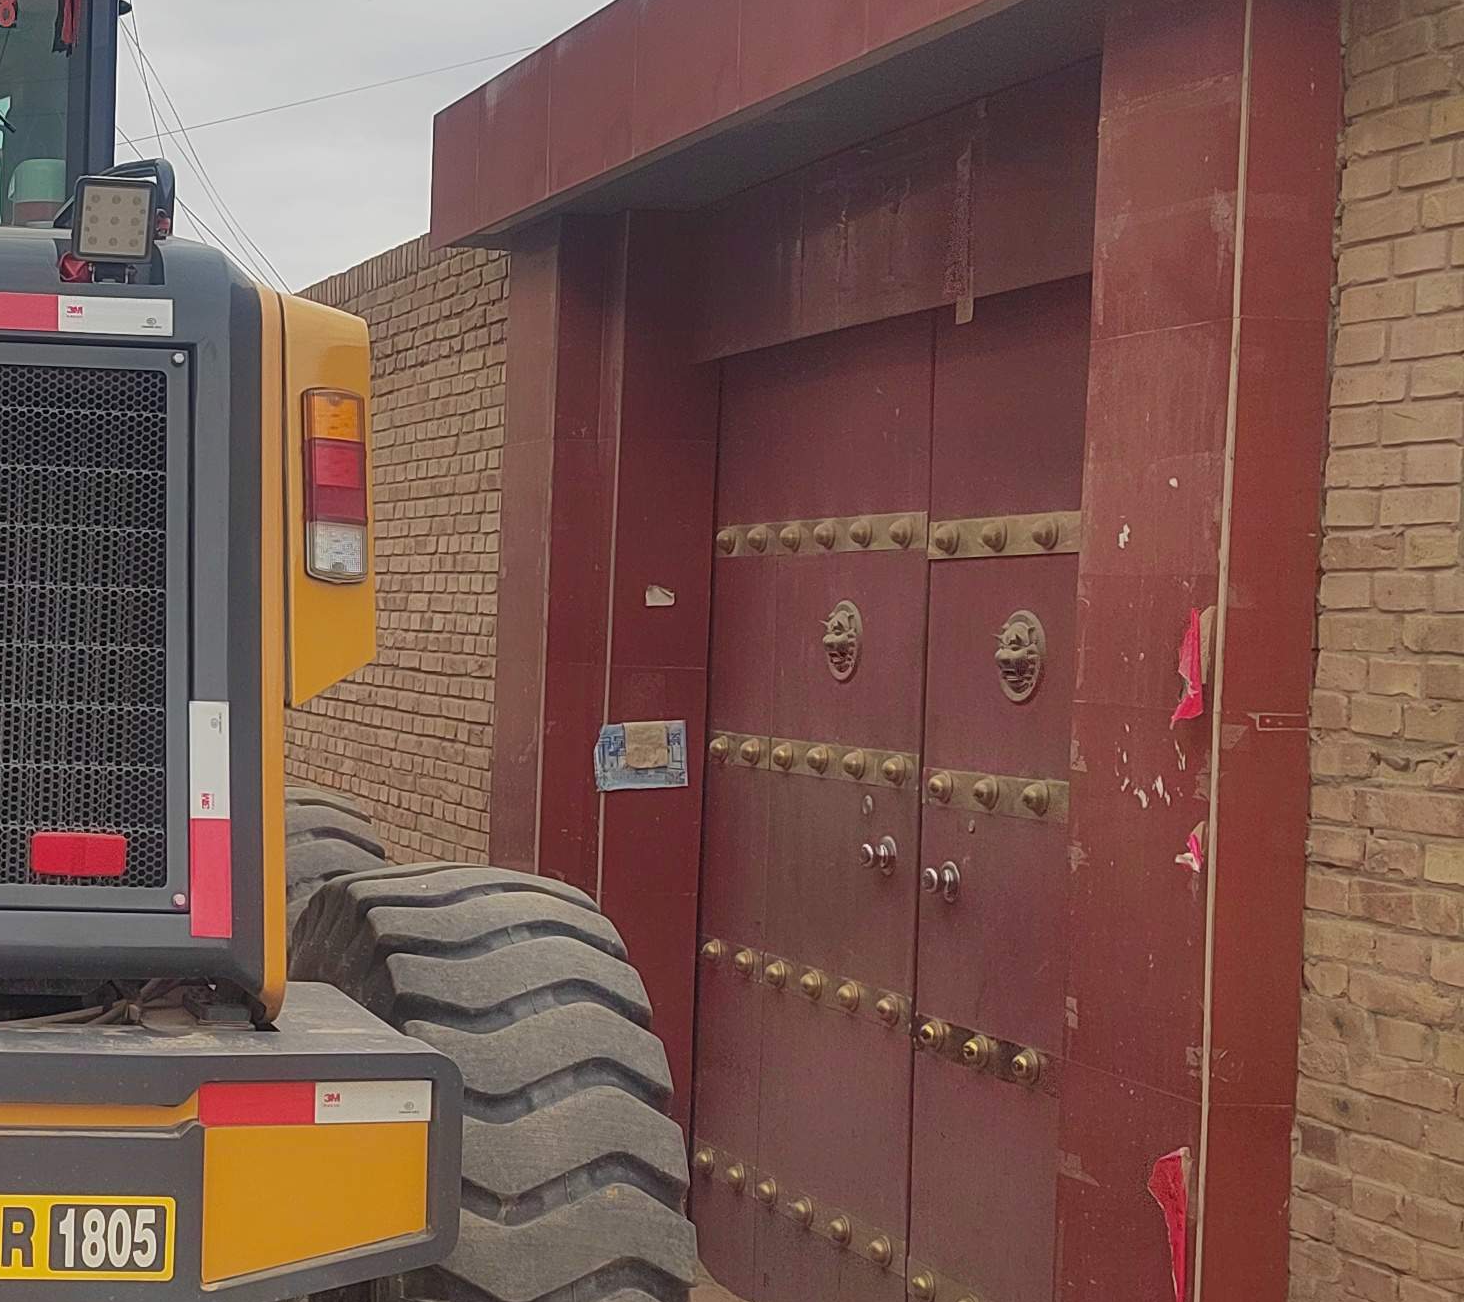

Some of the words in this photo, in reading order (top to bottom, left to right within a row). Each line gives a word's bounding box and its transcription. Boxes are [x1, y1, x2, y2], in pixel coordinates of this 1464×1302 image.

[66, 306, 83, 315] 3M
[323, 1093, 340, 1103] 3M
[58, 1208, 157, 1268] 1805
